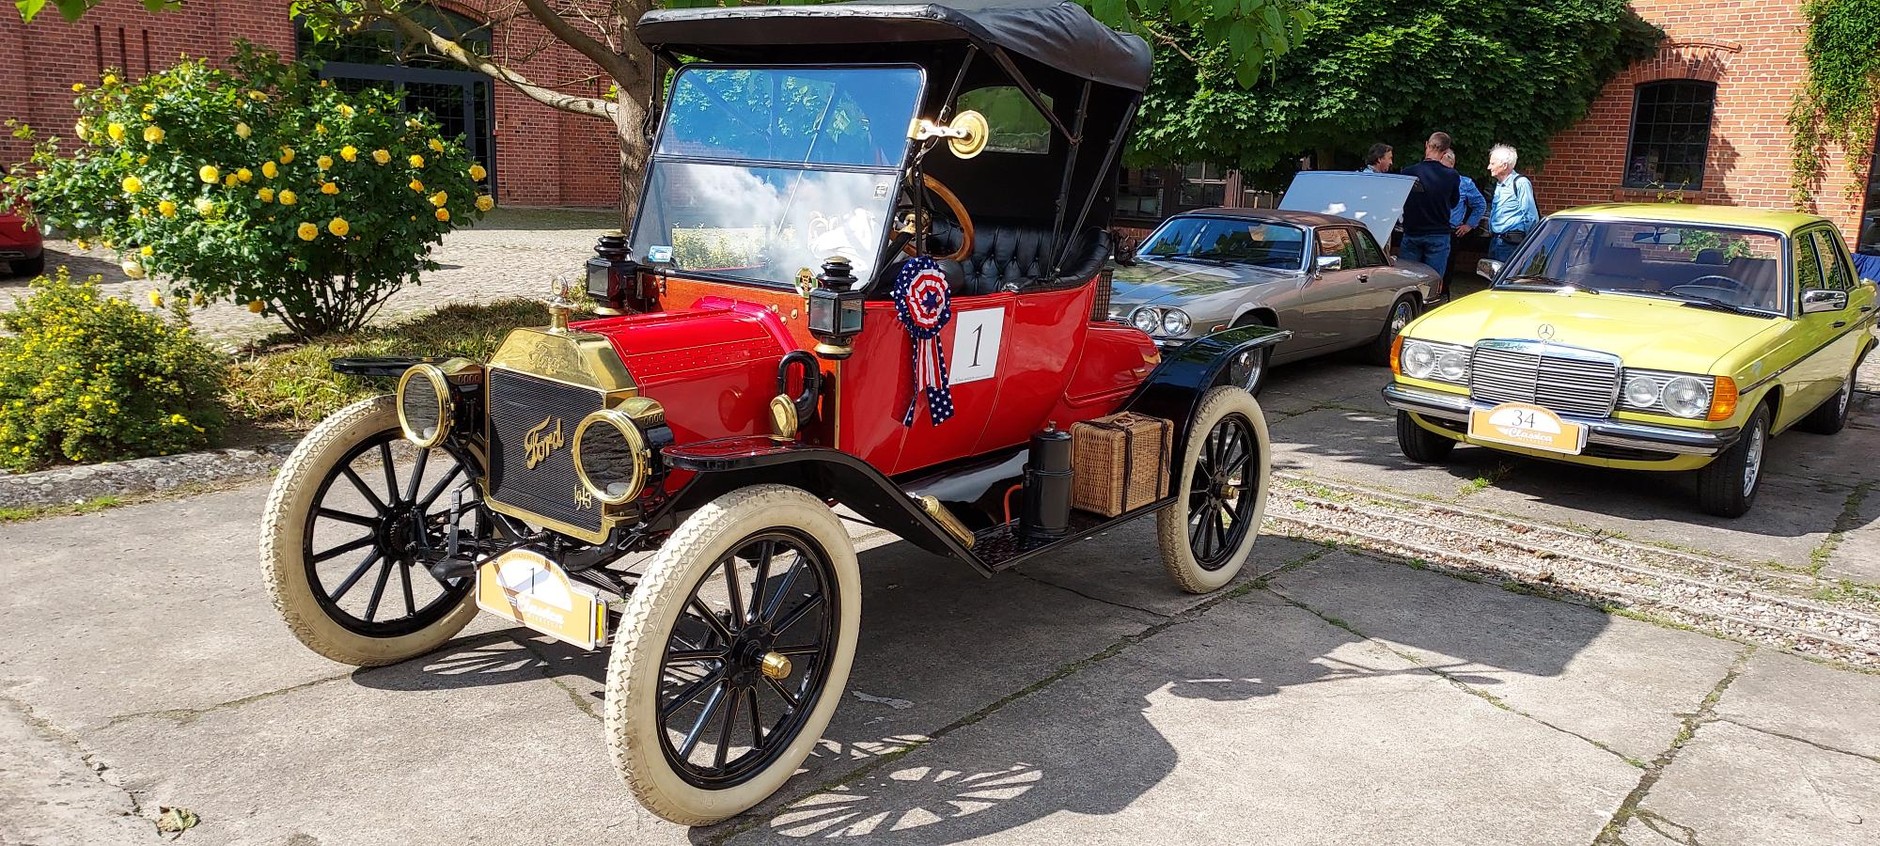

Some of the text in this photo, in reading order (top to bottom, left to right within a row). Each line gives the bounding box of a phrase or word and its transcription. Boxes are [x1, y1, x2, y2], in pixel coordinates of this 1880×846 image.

[967, 323, 983, 368] 1
[1511, 409, 1536, 428] 34
[524, 414, 564, 470] Ford
[528, 567, 535, 595] 1
